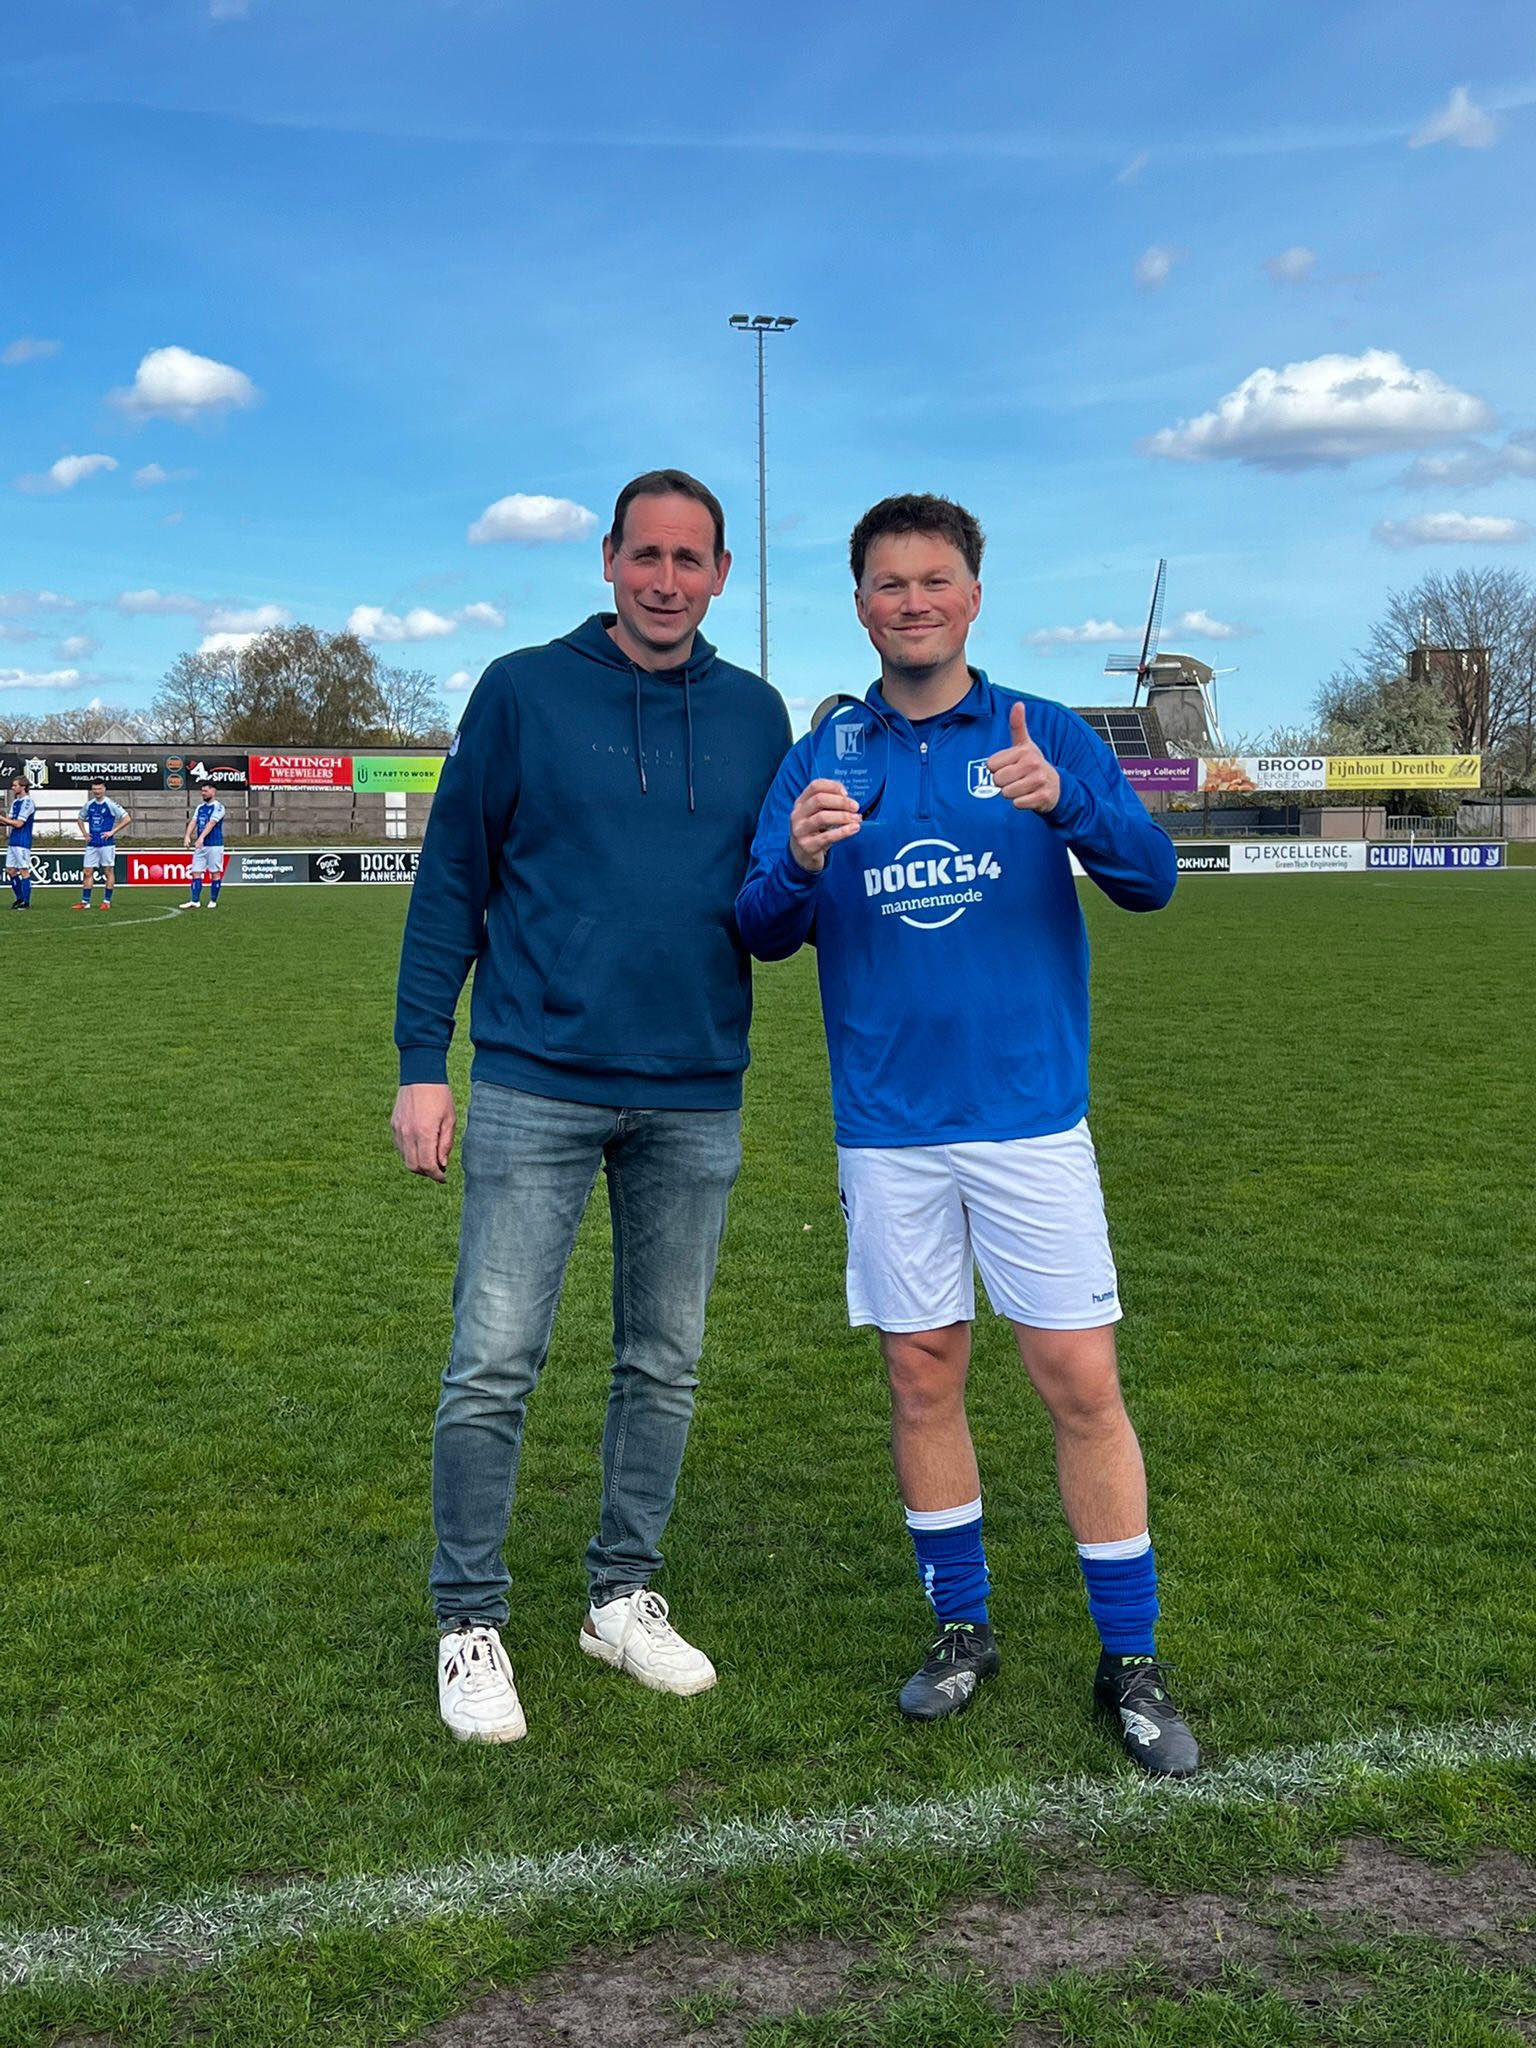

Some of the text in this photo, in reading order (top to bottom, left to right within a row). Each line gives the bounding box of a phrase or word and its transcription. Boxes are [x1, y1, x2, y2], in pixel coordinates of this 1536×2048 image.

[260, 756, 342, 767] ZANTINGH
[1258, 759, 1323, 771] BROOD
[66, 762, 128, 773] DRENTSCHE
[129, 763, 158, 773] HUYS
[270, 768, 333, 778] TWEEWIELERS
[1123, 767, 1190, 777] kerings Collectief
[1328, 760, 1446, 777] Fijnhout Drenthe
[1275, 780, 1323, 788] GEZOND
[1370, 847, 1481, 866] CLUB VAN 100
[320, 859, 340, 870] DOCK
[360, 854, 420, 871] DOCK 5
[1175, 857, 1229, 869] OKHUT.NL
[361, 871, 417, 881] MANNENMO
[881, 889, 983, 916] mannenmode
